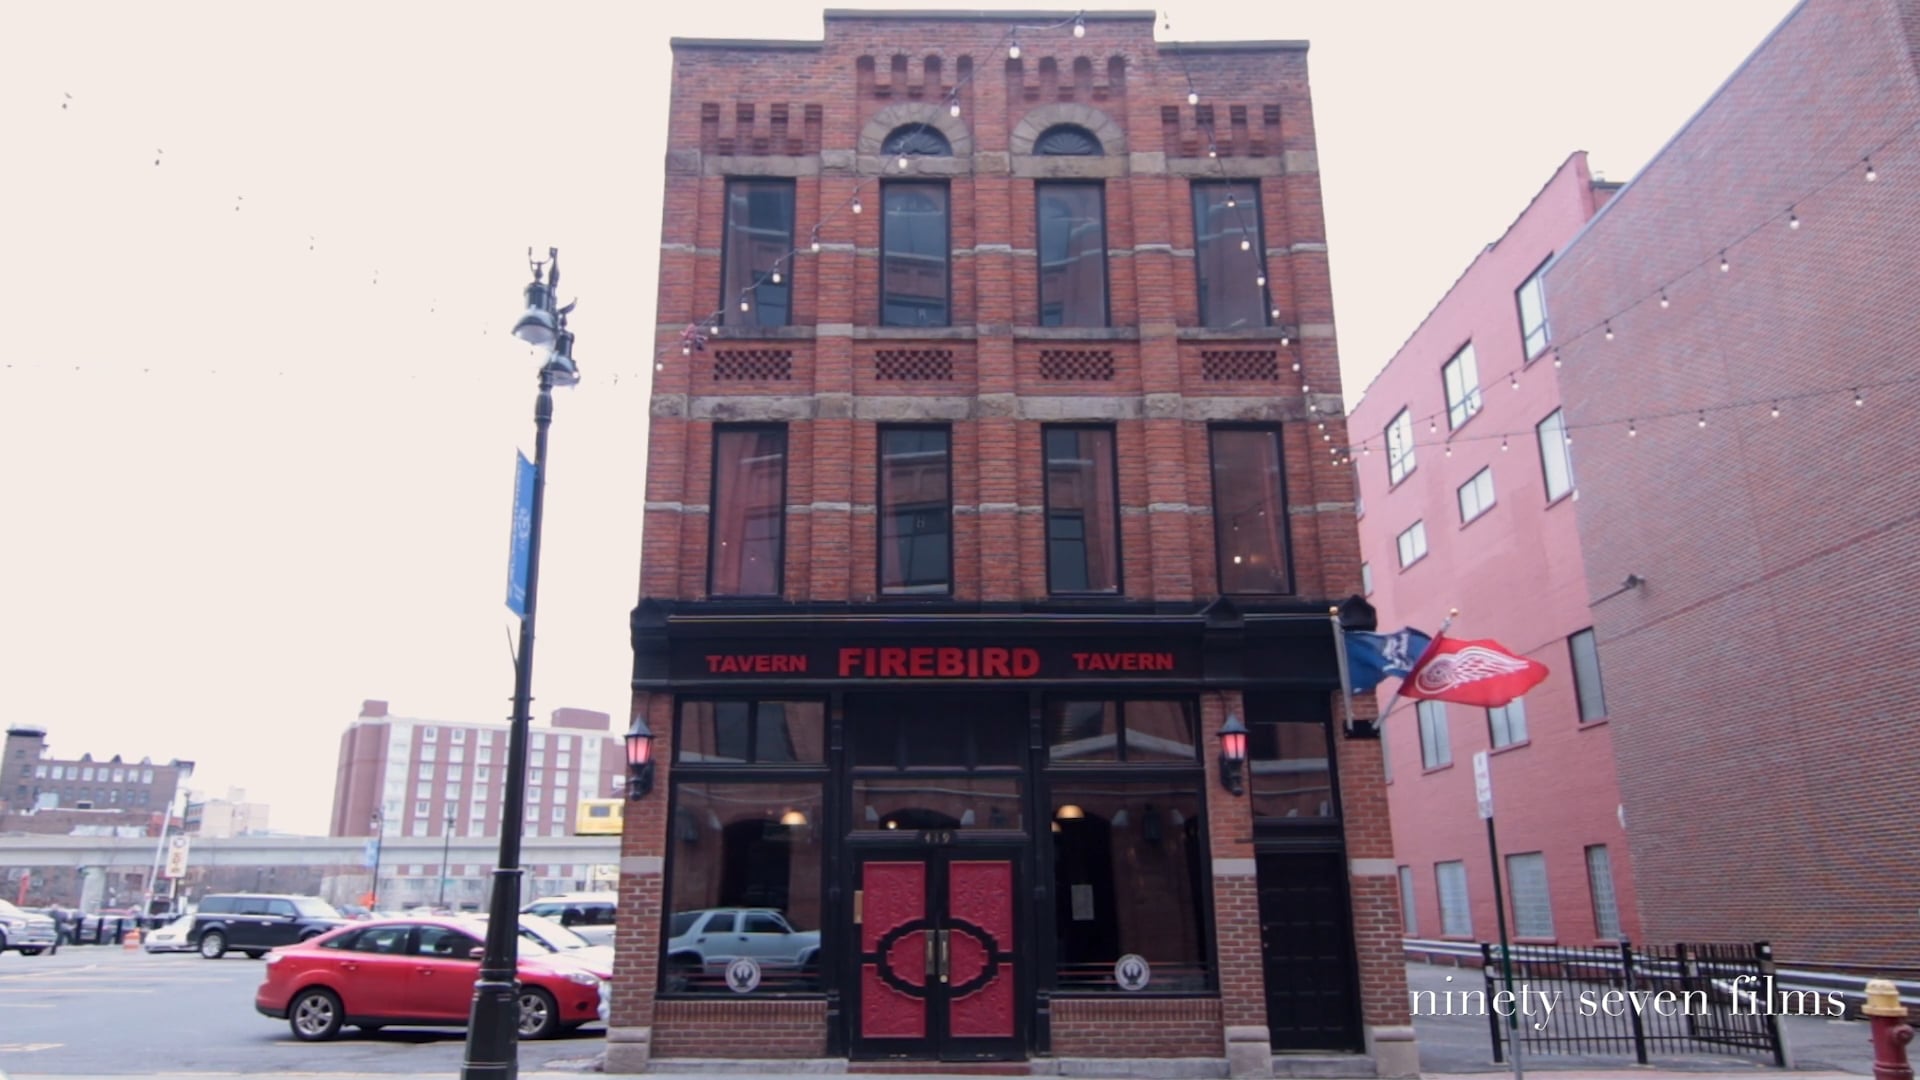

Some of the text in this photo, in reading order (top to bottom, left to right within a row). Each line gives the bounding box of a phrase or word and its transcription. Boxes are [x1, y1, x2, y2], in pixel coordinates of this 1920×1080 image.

[705, 647, 1175, 678] TAVERN FIREBIRD TAVERN
